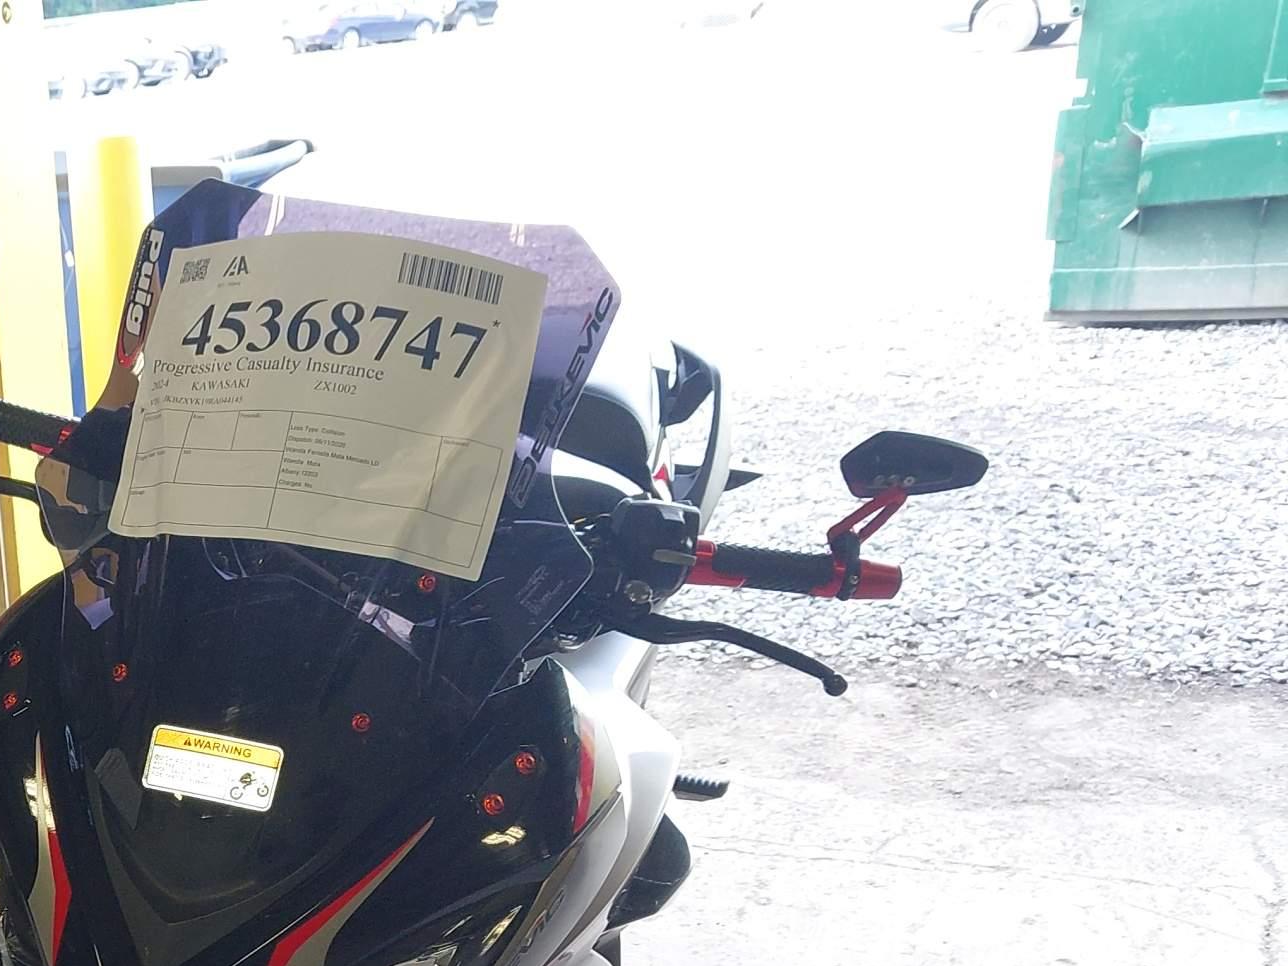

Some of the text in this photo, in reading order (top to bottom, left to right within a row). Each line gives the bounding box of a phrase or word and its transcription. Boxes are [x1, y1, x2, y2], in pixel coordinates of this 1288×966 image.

[125, 228, 165, 337] Puig
[181, 299, 488, 379] 45368747
[152, 355, 385, 381] Progressive Casualty Insurance
[191, 378, 251, 392] KAWASAKI
[313, 379, 358, 396] ZX1002
[194, 738, 252, 759] WARNING
